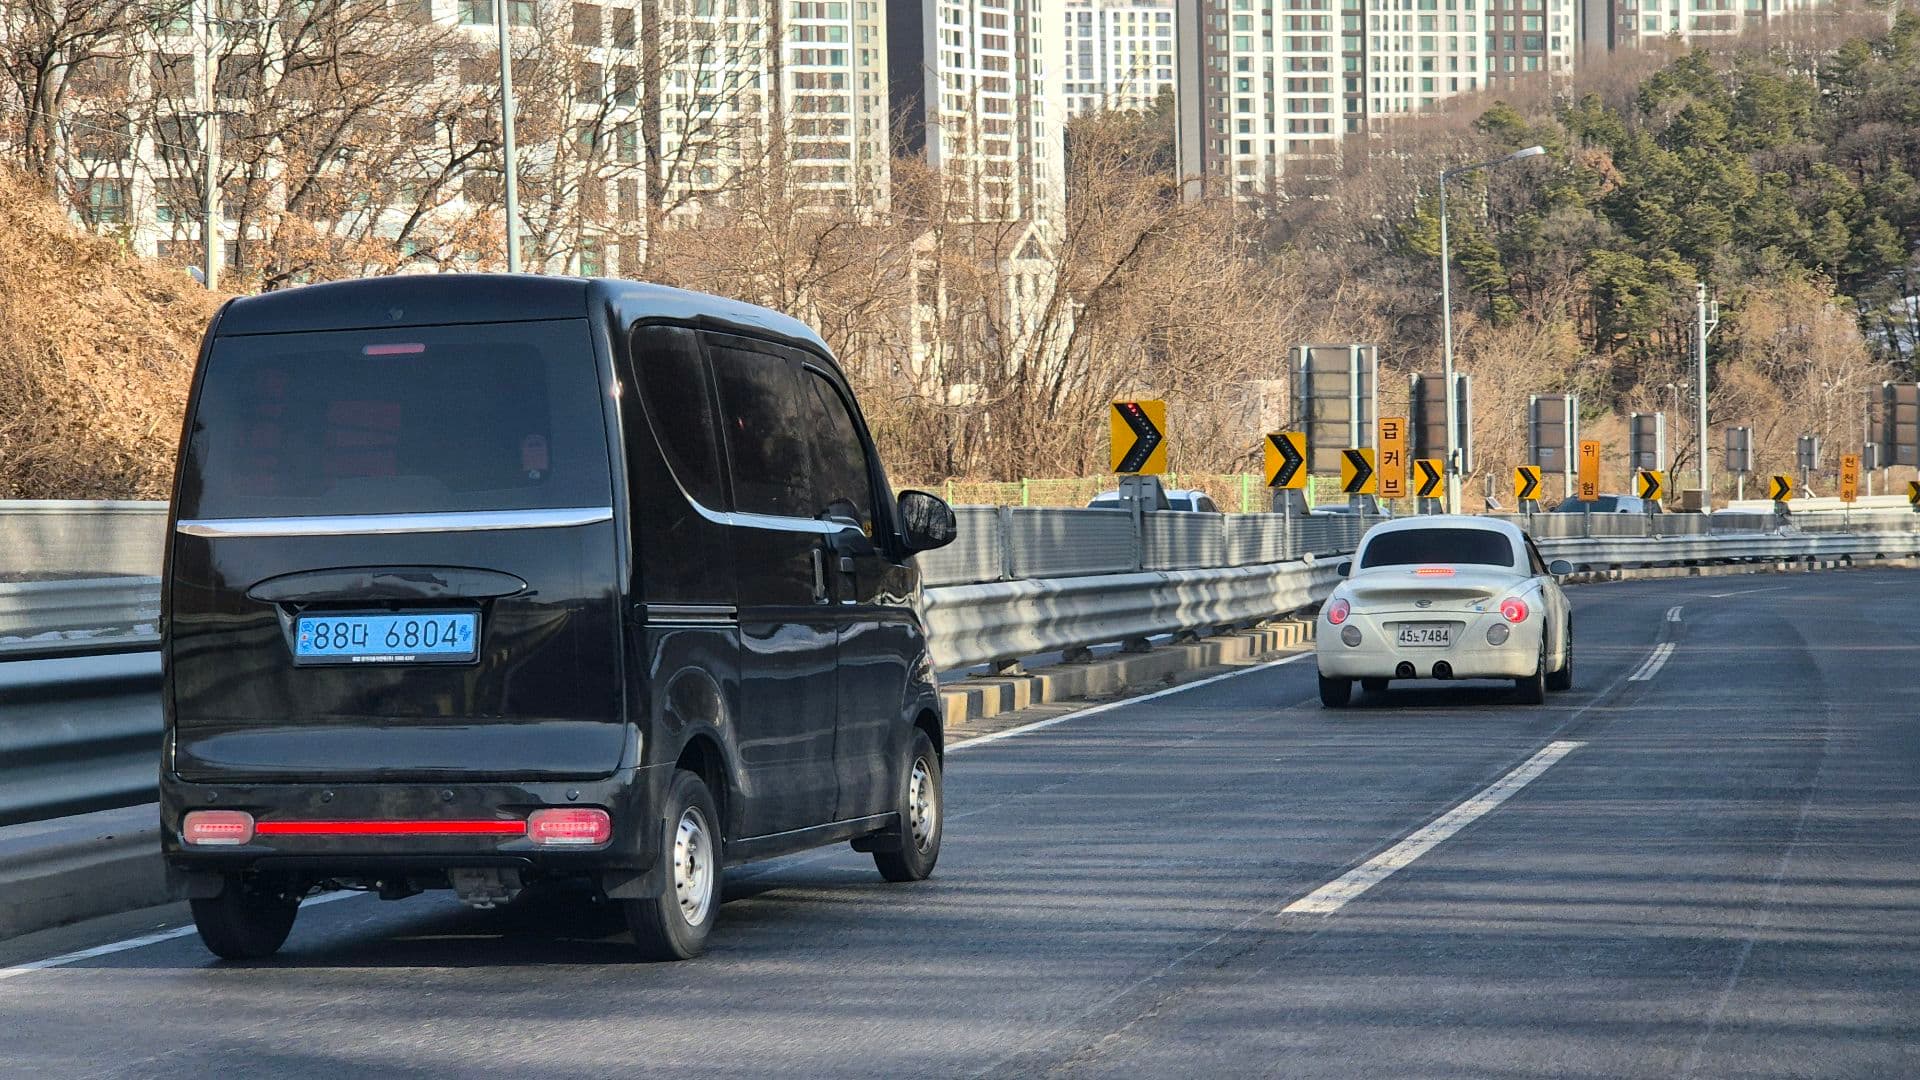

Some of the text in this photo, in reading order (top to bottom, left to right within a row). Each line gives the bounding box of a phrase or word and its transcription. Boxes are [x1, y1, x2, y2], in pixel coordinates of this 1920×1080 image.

[1382, 422, 1401, 493] 급커브
[1583, 444, 1595, 496] 위험
[313, 619, 458, 650] 88다 6804
